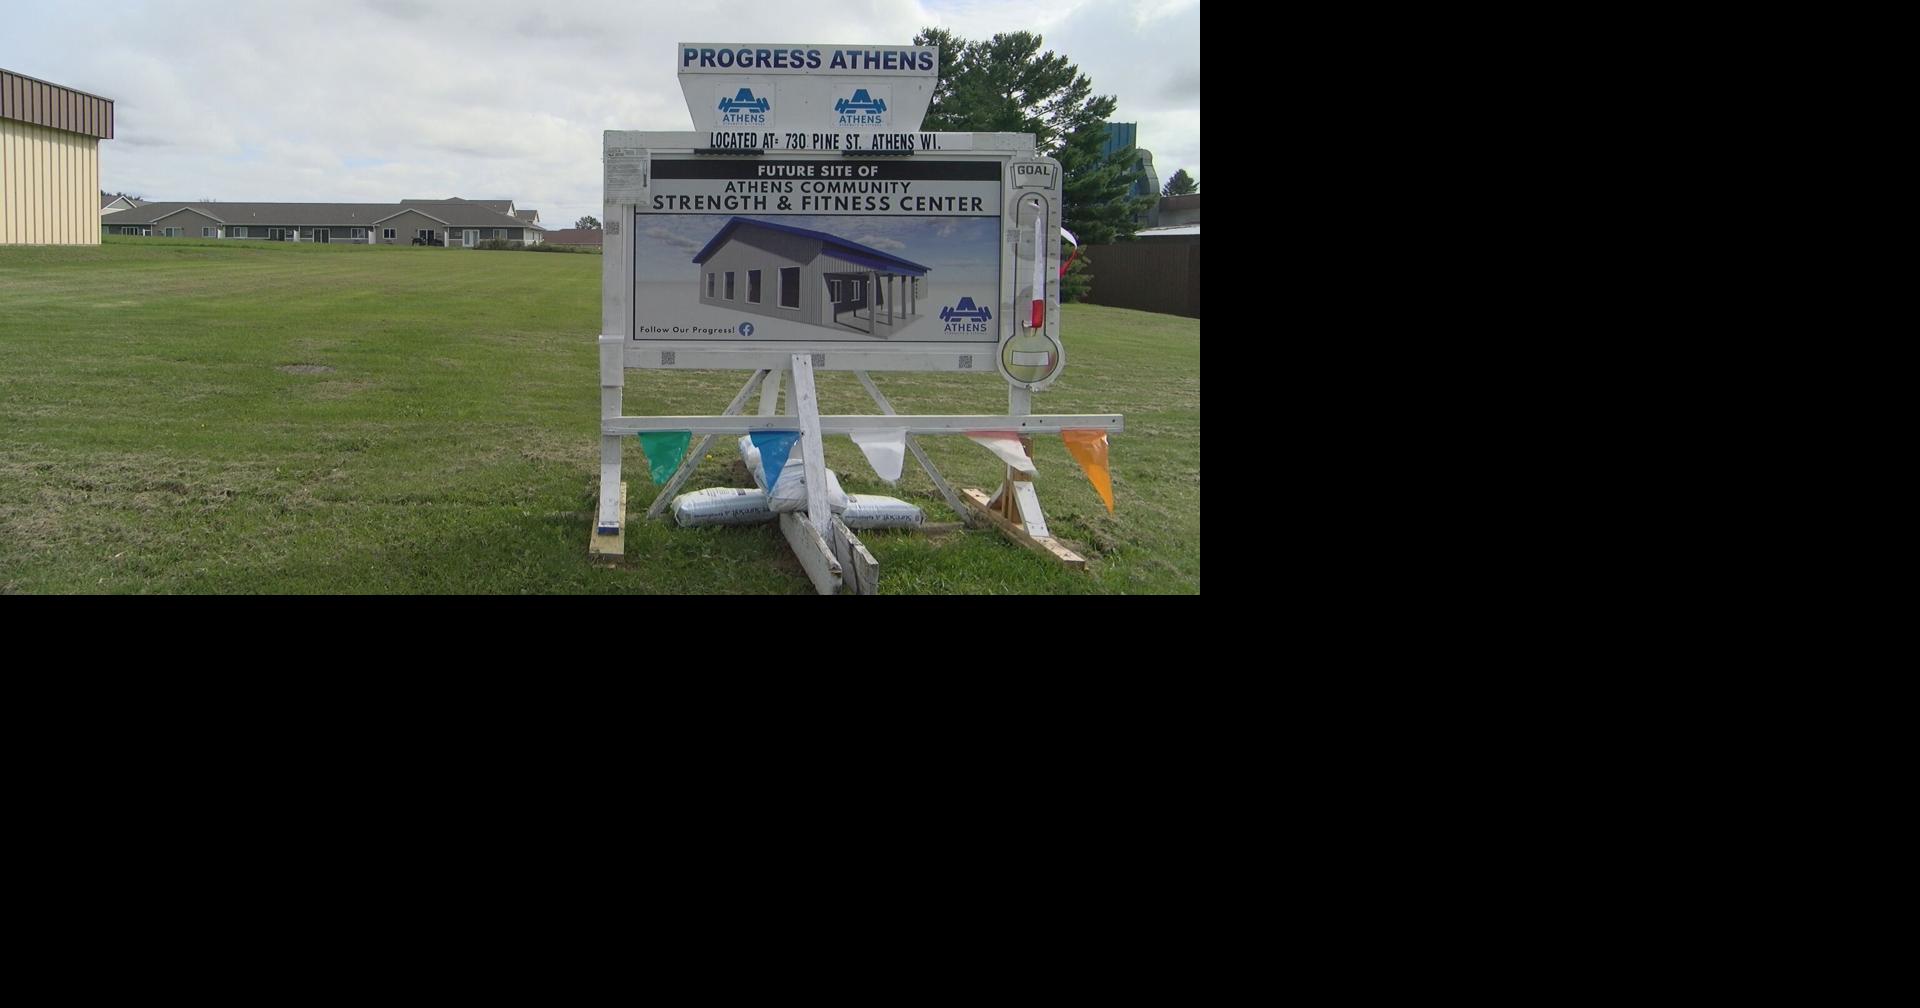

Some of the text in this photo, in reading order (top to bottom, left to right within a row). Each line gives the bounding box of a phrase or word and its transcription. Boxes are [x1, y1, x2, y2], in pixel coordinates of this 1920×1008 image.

[683, 48, 934, 71] PROGRESS ATHENS
[722, 114, 765, 123] ATHENS
[839, 115, 882, 124] ATHENS
[710, 132, 757, 149] LOCATED
[786, 133, 806, 149] 730
[813, 133, 839, 149] PINE
[846, 133, 862, 150] ST.
[872, 133, 915, 150] ATHENS
[920, 134, 941, 150] WI.
[758, 165, 878, 177] FUTURE SITE OF
[1017, 165, 1050, 176] GOAL
[725, 181, 911, 194] ATHENS COMMUNITY
[653, 195, 984, 212] STRENGTH & FITNESS CENTER
[640, 325, 735, 335] Follow Our Progress!
[944, 323, 987, 332] ATHENS
